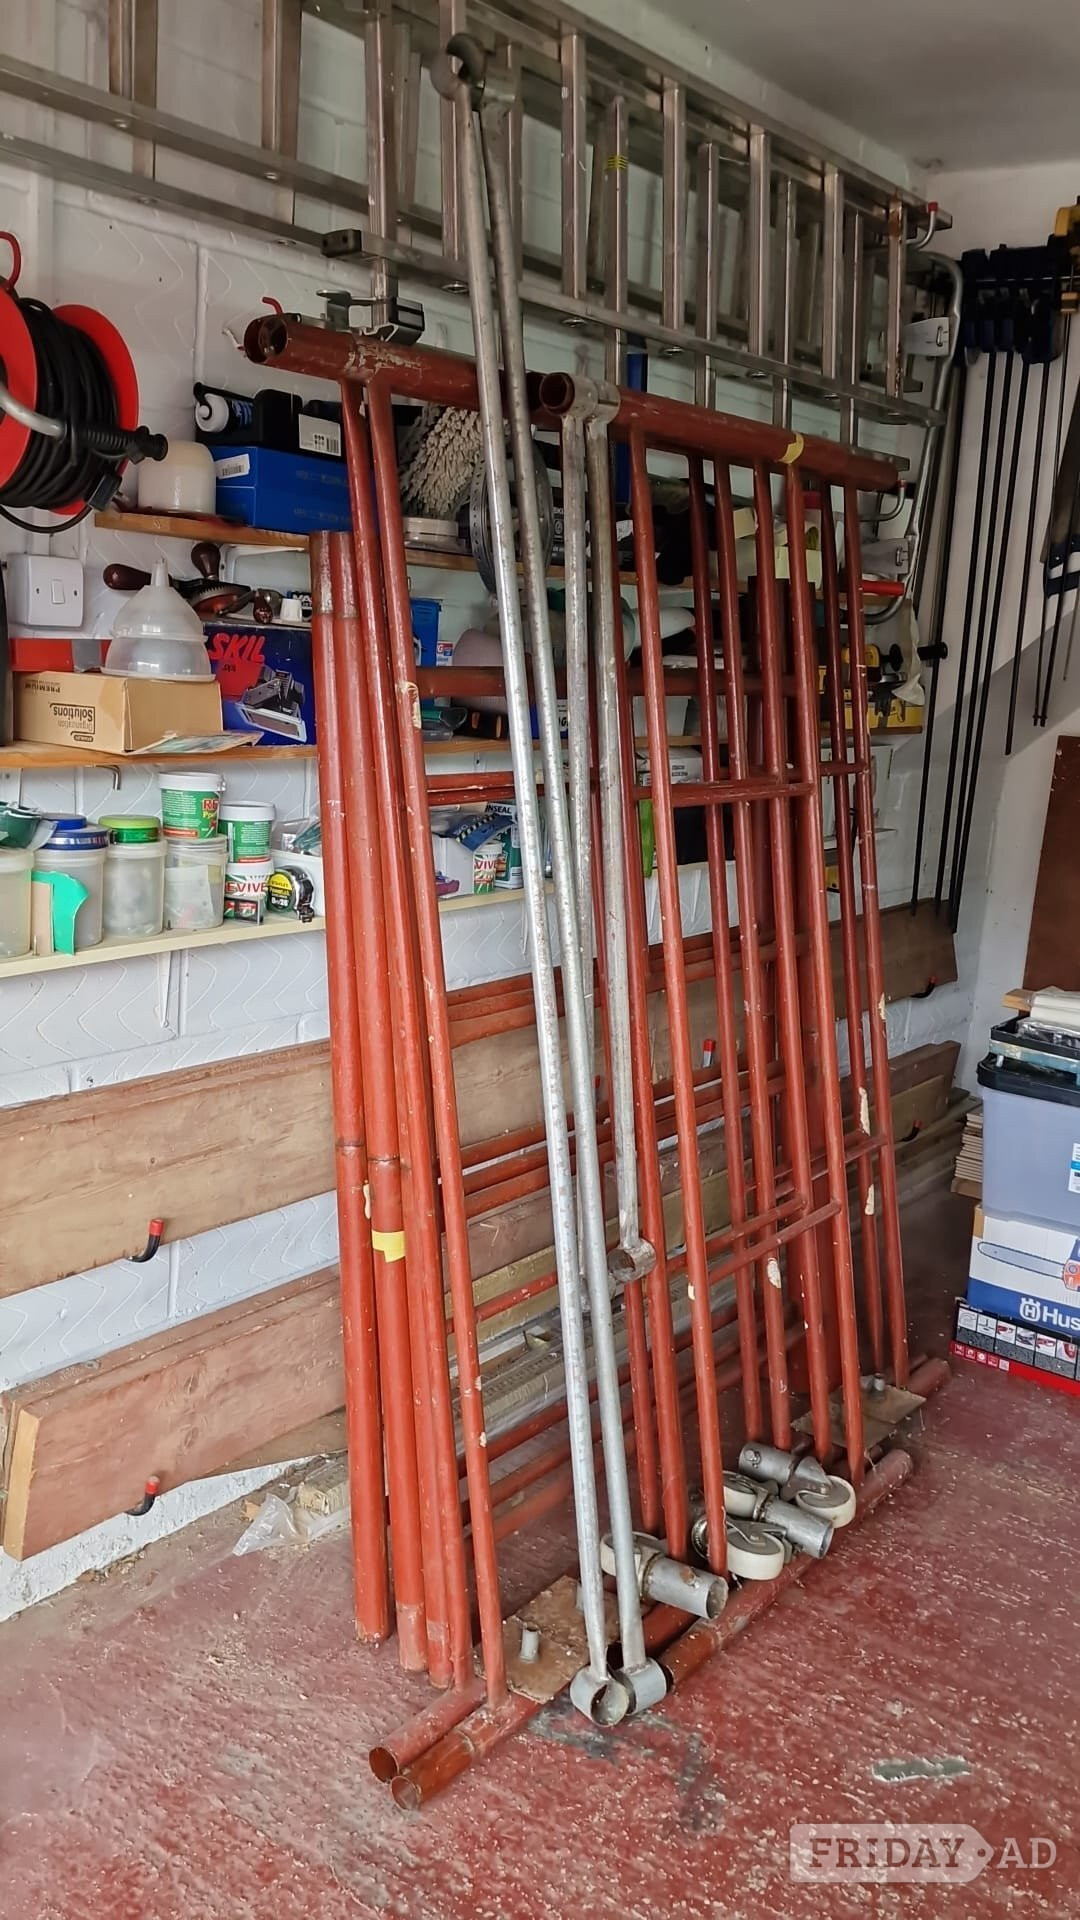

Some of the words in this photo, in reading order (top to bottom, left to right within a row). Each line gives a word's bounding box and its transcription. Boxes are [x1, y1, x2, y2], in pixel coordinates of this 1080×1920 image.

[208, 633, 266, 663] SKIL
[24, 682, 61, 694] PREMIUM
[53, 705, 93, 722] Solutions
[225, 882, 267, 893] EVIVE
